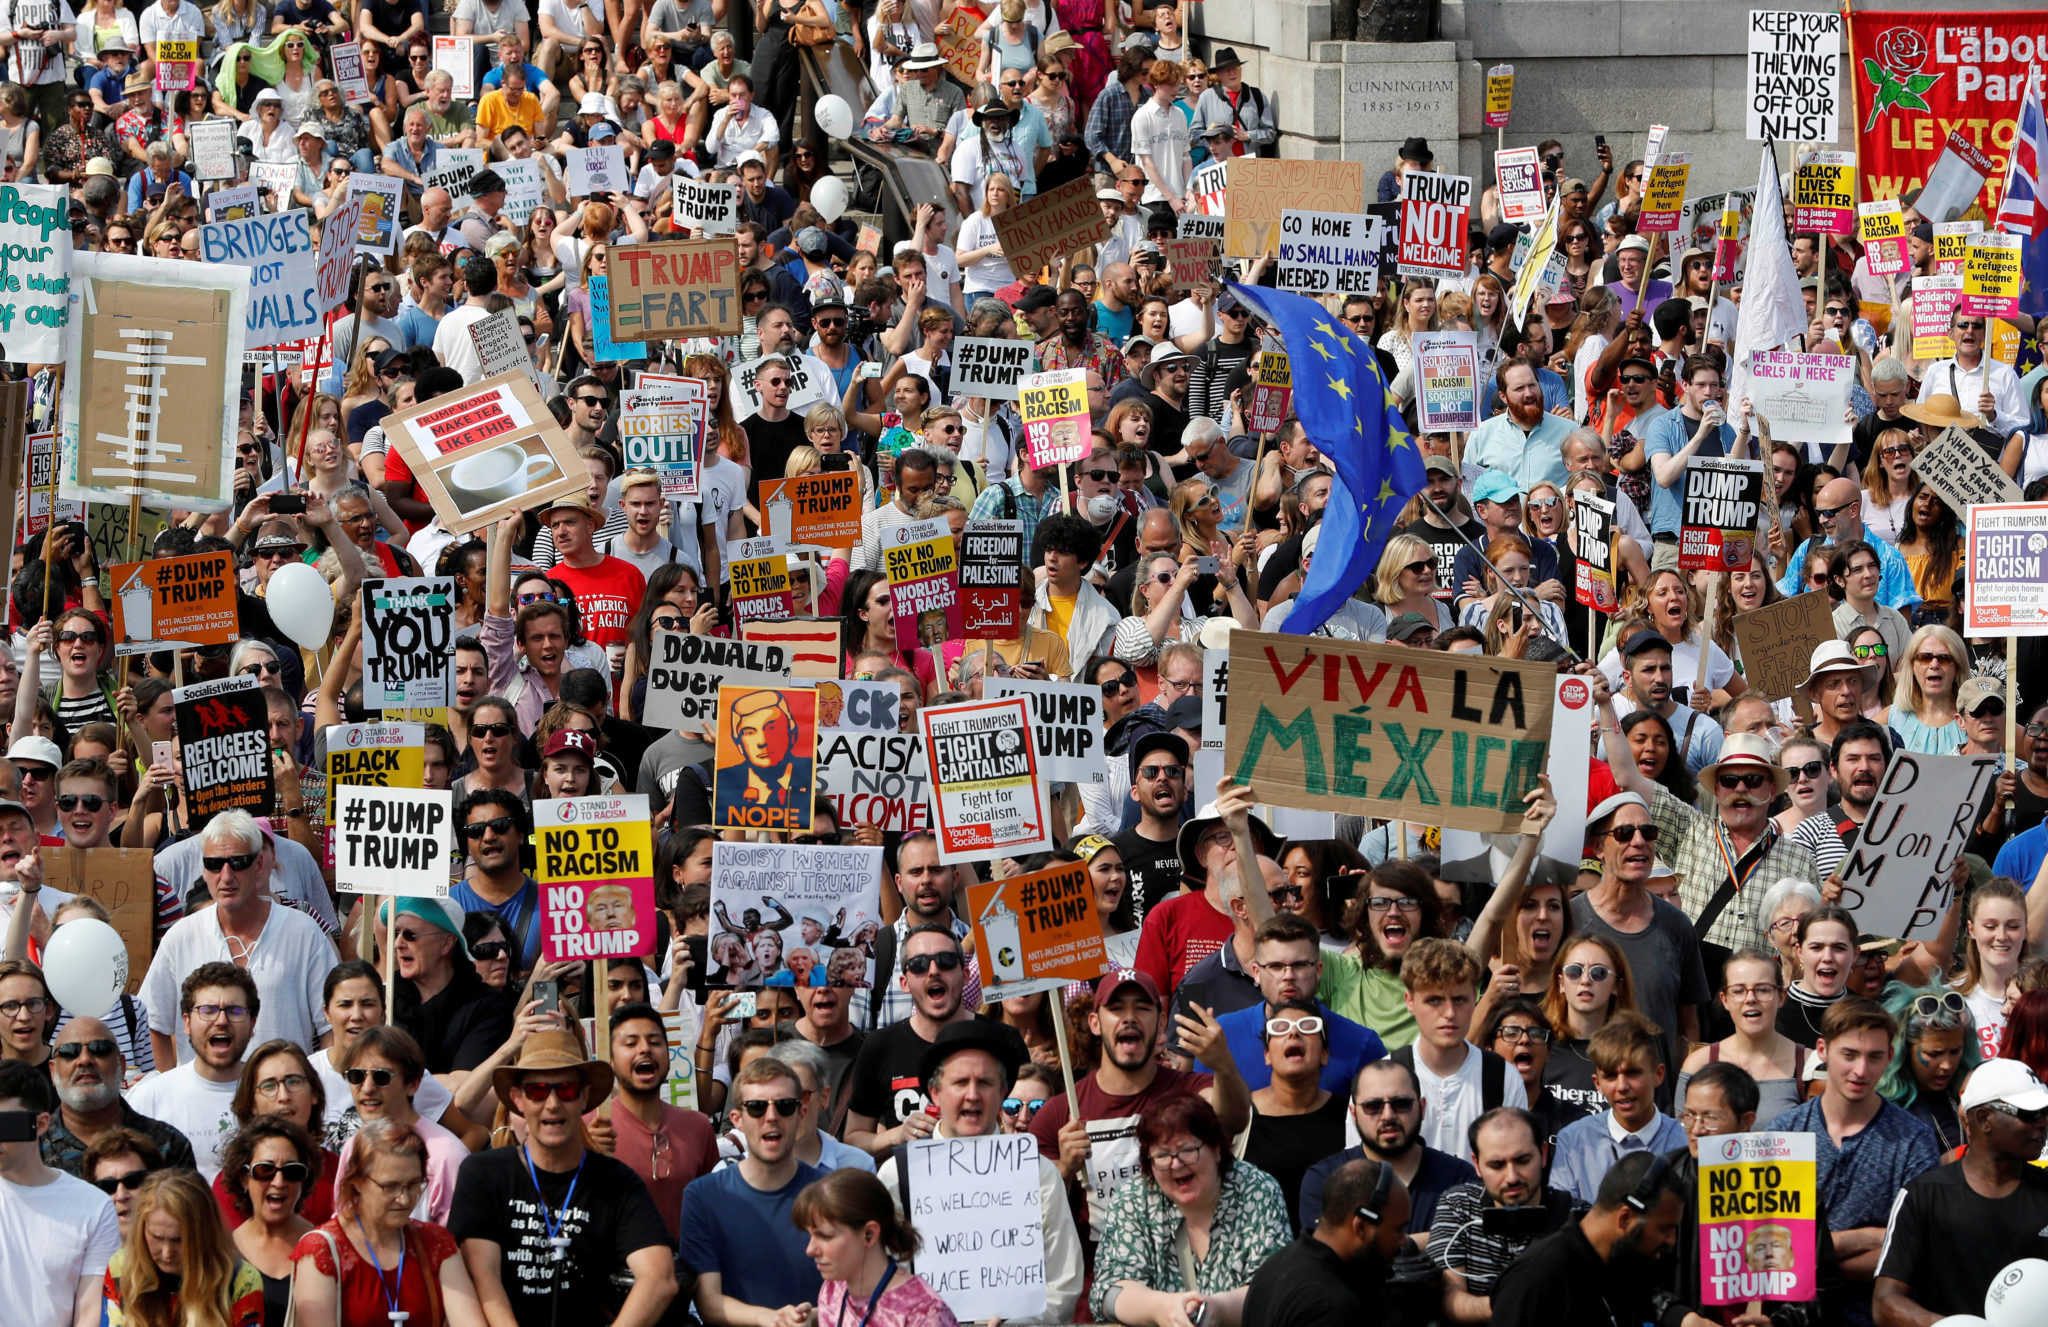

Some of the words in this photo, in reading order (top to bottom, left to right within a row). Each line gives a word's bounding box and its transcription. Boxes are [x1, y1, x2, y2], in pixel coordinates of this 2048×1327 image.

[1946, 27, 1977, 37] THE
[1769, 32, 1821, 53] TINY
[160, 51, 191, 60] RACISM
[1751, 52, 1836, 76] THIEVING
[159, 80, 189, 89] TRUMP
[1349, 80, 1454, 93] CUNNINGHAM
[1755, 75, 1830, 98] HANDS
[1799, 166, 1841, 179] BLACK
[677, 182, 732, 205] #DUMP
[1405, 174, 1469, 205] TRUMP
[1502, 177, 1533, 191] SEXISM
[1799, 179, 1834, 192] LIVES
[678, 199, 729, 221] TRUMP
[1799, 193, 1851, 207] MATTER
[1405, 200, 1465, 248] NOT
[1863, 216, 1875, 227] NO
[1877, 215, 1890, 225] TO
[1864, 224, 1900, 238] RACISM
[203, 213, 311, 263] BRIDGES
[1280, 243, 1294, 260] NO
[1296, 244, 1342, 265] SMALL
[1344, 247, 1380, 268] HANDS
[1403, 242, 1462, 267] WELCOME
[1868, 252, 1882, 263] TO
[618, 250, 735, 287] TRUMP
[1400, 265, 1423, 275] TOGETHER
[1424, 268, 1445, 278] AGAINST
[1446, 270, 1462, 279] TRUMP
[1869, 260, 1904, 273] TRUMP
[1972, 272, 2012, 283] welcome
[1981, 283, 2002, 293] here
[959, 344, 1029, 366] #DUMP
[1262, 355, 1274, 369] NO
[1277, 356, 1287, 370] TO
[1423, 355, 1469, 367] SOLIDARITY
[1260, 369, 1290, 384] RACISM
[1437, 367, 1458, 377] NOT
[1753, 364, 1785, 378] GIRLS
[1790, 367, 1801, 379] IN
[1806, 367, 1836, 381] HERE
[1432, 378, 1466, 388] RACISM!
[635, 395, 674, 403] Socialist
[1024, 390, 1046, 405] NO
[1049, 387, 1070, 401] TO
[1428, 391, 1471, 402] SOCIALISM
[1026, 399, 1081, 419] RACISM
[431, 415, 472, 435] MAKE
[475, 404, 502, 420] TEA
[624, 414, 690, 435] TORIES
[1253, 415, 1280, 430] TRUMP
[1028, 422, 1050, 438] NO
[1031, 437, 1050, 450] TO
[796, 477, 853, 499] #DUMP
[1688, 470, 1748, 500] DUMP
[797, 495, 852, 515] TRUMP
[1687, 497, 1756, 527] TRUMP
[836, 520, 859, 529] POLICIES
[971, 522, 996, 532] Socialist
[996, 523, 1015, 532] Worker
[1976, 516, 2000, 528] FIGHT
[2002, 515, 2047, 527] TRUMPISM
[966, 536, 1017, 556] FREEDOM
[1683, 530, 1709, 543] FIGHT
[1976, 534, 2024, 557] FIGHT
[888, 549, 913, 566] SAY
[917, 543, 934, 560] NO
[1682, 542, 1720, 557] BIGOTRY
[732, 563, 757, 580] SAY
[760, 560, 771, 573] NO
[890, 566, 909, 581] TO
[911, 555, 953, 577] TRUMP
[988, 555, 998, 565] for
[1975, 556, 2040, 579] RACISM
[156, 558, 226, 586] #DUMP
[962, 565, 1018, 585] PALESTINE
[158, 579, 225, 605] TRUMP
[733, 579, 750, 594] TO
[753, 574, 786, 592] TRUMP
[1976, 583, 1993, 594] Fight
[1995, 584, 2004, 593] for
[2005, 583, 2020, 595] jobs
[2021, 584, 2044, 593] homes
[387, 595, 429, 609] THANK
[588, 599, 629, 614] AMERICA
[1975, 594, 1988, 602] and
[1989, 594, 2016, 603] services
[2018, 594, 2028, 602] for
[2029, 593, 2038, 602] all
[157, 614, 205, 627] ANTI-PALESTINE
[206, 610, 234, 620] POLICIES
[160, 624, 204, 636] ISLAMOPHOBIA
[210, 620, 234, 629] RACISM
[183, 683, 221, 701] Socialist
[221, 679, 253, 691] Worker
[1562, 691, 1586, 700] TRUMP
[1565, 684, 1584, 694] STOP
[365, 728, 387, 736] STAND
[932, 721, 960, 736] FIGHT
[962, 713, 1017, 732] TRUMPISM
[184, 729, 267, 768] REFUGEES
[365, 736, 374, 744] TO
[376, 736, 404, 744] RACISM
[564, 732, 583, 749] H
[935, 733, 992, 763] FIGHT
[186, 753, 268, 791] WELCOME
[938, 753, 1029, 783] CAPITALISM
[196, 789, 214, 803] Open
[214, 785, 229, 796] the
[230, 780, 266, 793] borders
[961, 791, 992, 809] Fight
[996, 789, 1014, 802] for
[580, 801, 607, 811] STAND
[609, 800, 622, 809] UP
[581, 811, 592, 820] TO
[594, 809, 626, 820] RACISM
[959, 806, 1021, 824] socialism.
[344, 798, 444, 835] #DUMP
[545, 829, 579, 853] NO
[586, 827, 619, 851] TO
[949, 827, 976, 839] Young
[952, 835, 994, 847] Socialists
[346, 834, 438, 870] TRUMP
[1896, 832, 1931, 859] on
[546, 850, 639, 878] RACISM
[1155, 859, 1180, 870] NEVER
[548, 885, 584, 911] NO
[1020, 870, 1085, 908] #DUMP
[548, 909, 583, 934] TO
[1024, 898, 1088, 933] TRUMP
[550, 930, 640, 958] TRUMP
[1744, 1138, 1771, 1148] STAND
[1773, 1137, 1786, 1147] UP
[1744, 1148, 1756, 1158] TO
[1757, 1147, 1791, 1158] RACISM
[1709, 1167, 1742, 1193] NO
[1749, 1165, 1782, 1191] TO
[914, 1195, 933, 1216] AS
[940, 1190, 1012, 1212] WELCOME
[1023, 1189, 1040, 1209] AS
[1709, 1190, 1801, 1217] RACISM
[935, 1232, 983, 1255] WORLD
[990, 1229, 1020, 1250] CUP
[1709, 1225, 1743, 1252] NO
[508, 1249, 532, 1262] with
[1709, 1250, 1741, 1275] TO
[1709, 1271, 1797, 1300] TRUMP
